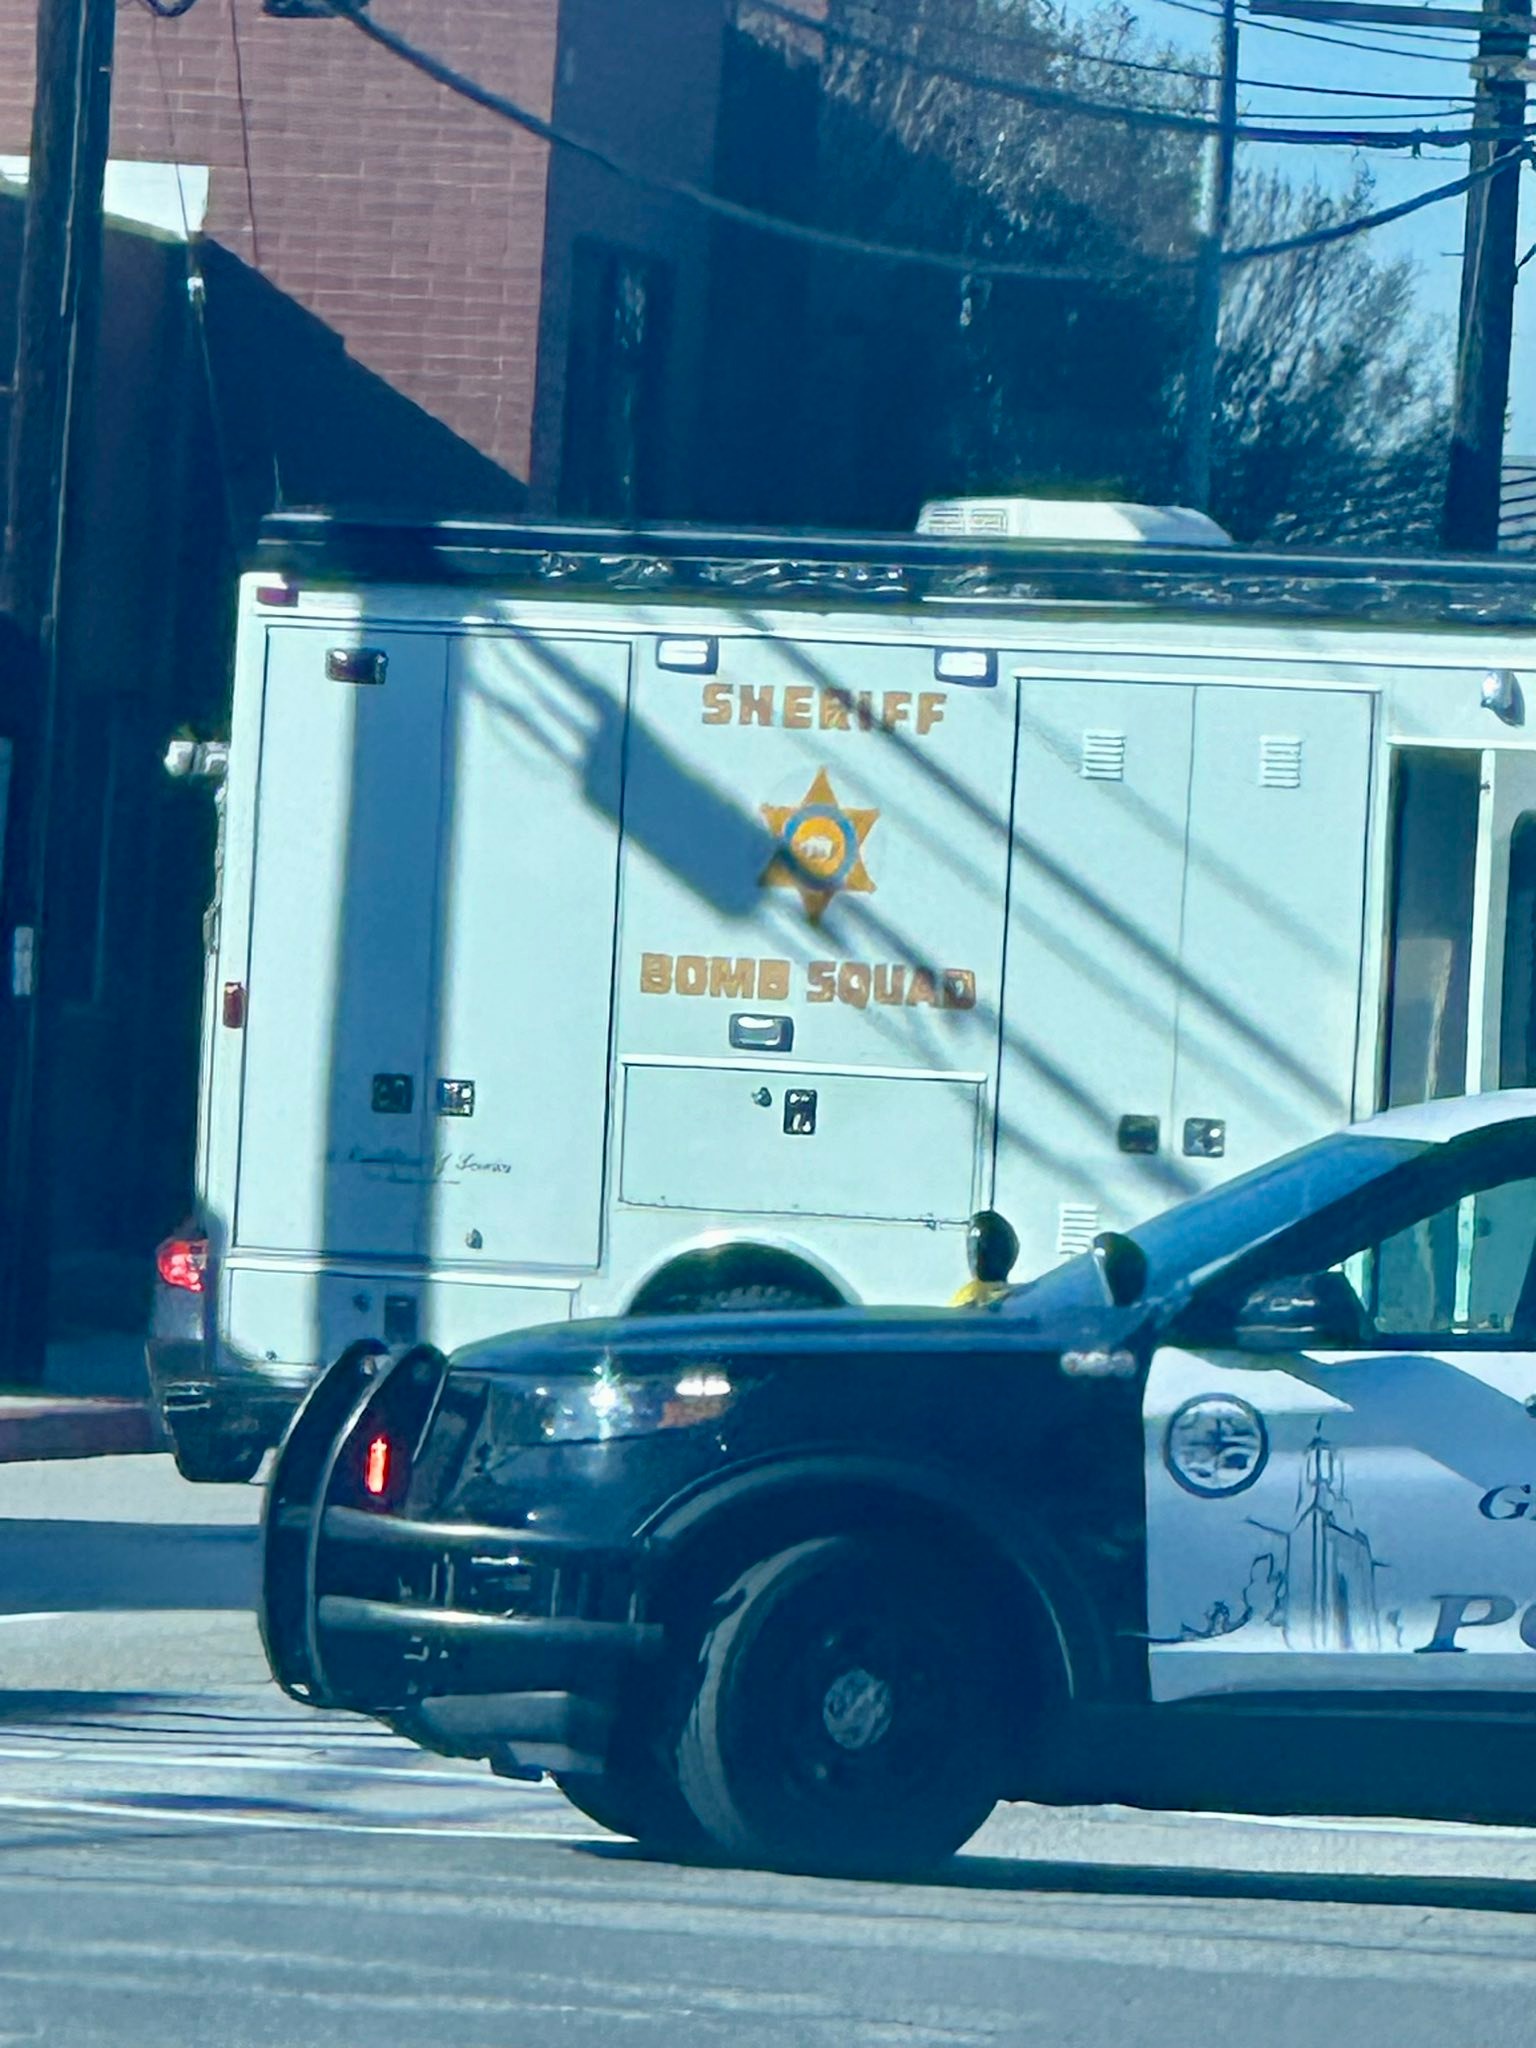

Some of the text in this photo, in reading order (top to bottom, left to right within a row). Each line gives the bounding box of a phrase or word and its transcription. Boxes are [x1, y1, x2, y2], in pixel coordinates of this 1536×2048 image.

[702, 682, 948, 735] SHERIFF
[640, 952, 976, 1010] BOMB SQUAD
[1478, 1484, 1536, 1521] G
